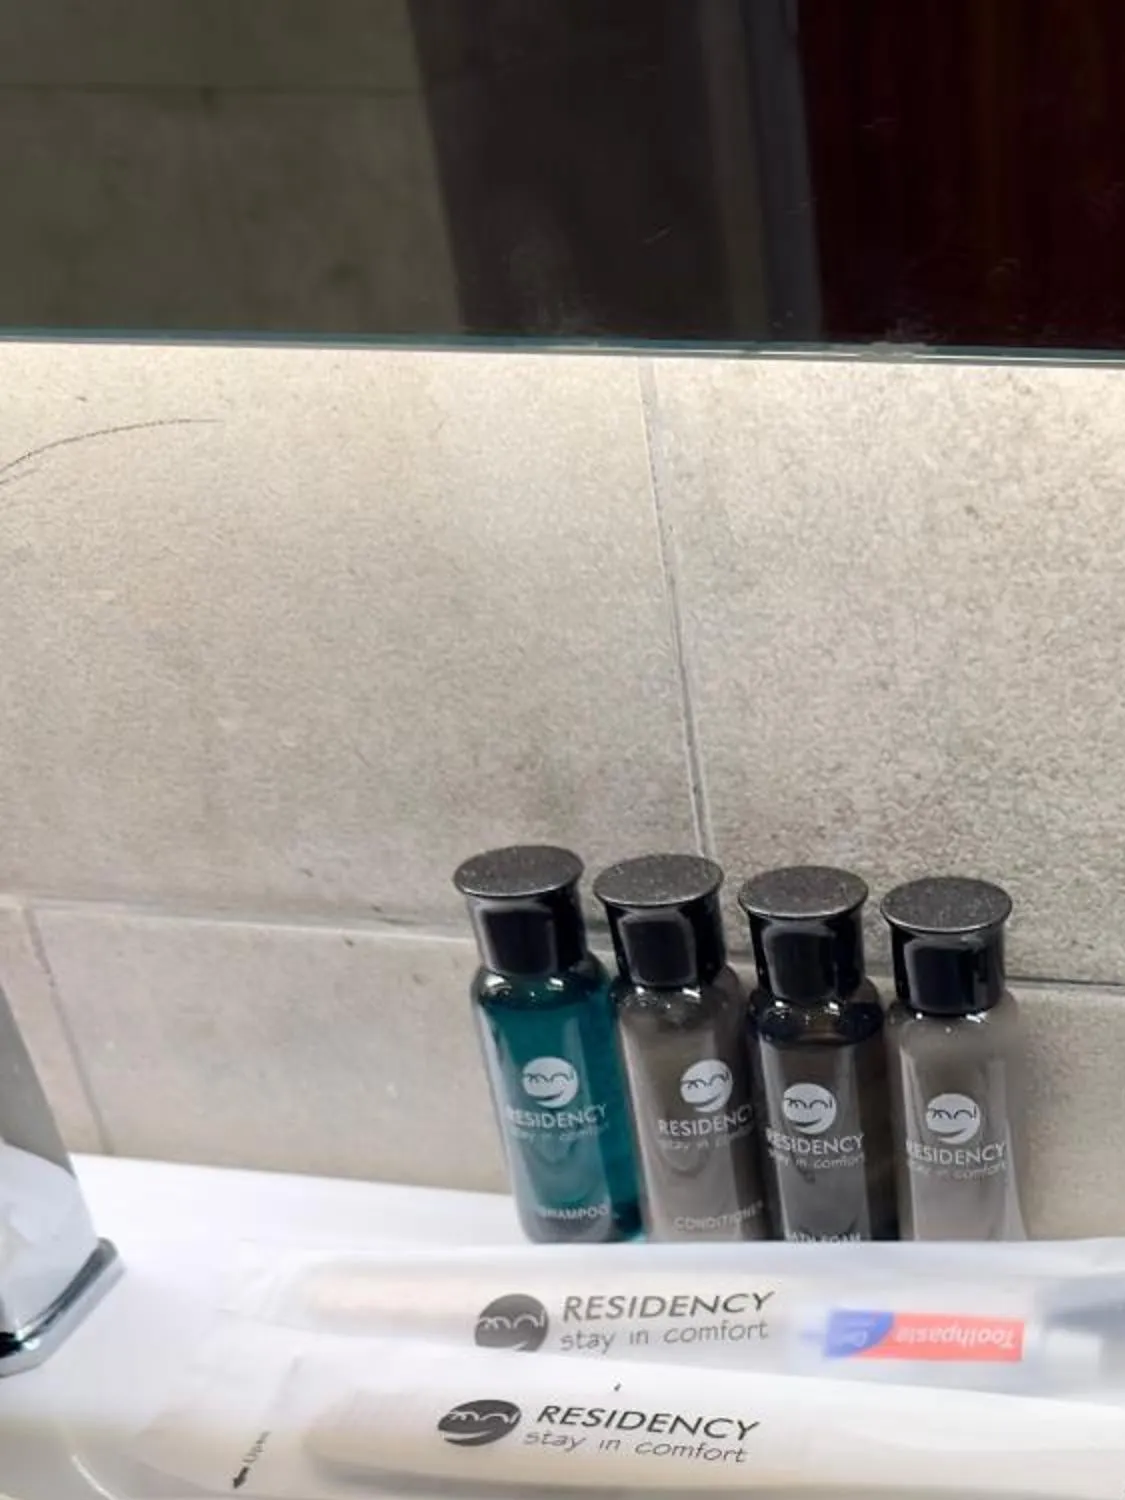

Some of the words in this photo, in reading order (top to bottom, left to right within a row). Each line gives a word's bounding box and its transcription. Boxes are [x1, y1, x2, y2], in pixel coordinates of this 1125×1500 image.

[658, 1104, 754, 1137] RESIDENC
[562, 1291, 775, 1322] RESIDENCY
[560, 1329, 616, 1355] stay
[629, 1329, 649, 1345] in
[663, 1320, 769, 1344] comfort
[537, 1404, 760, 1441] RESIDENCY
[523, 1430, 586, 1452] stay
[600, 1439, 621, 1450] in
[635, 1441, 749, 1463] comfort
